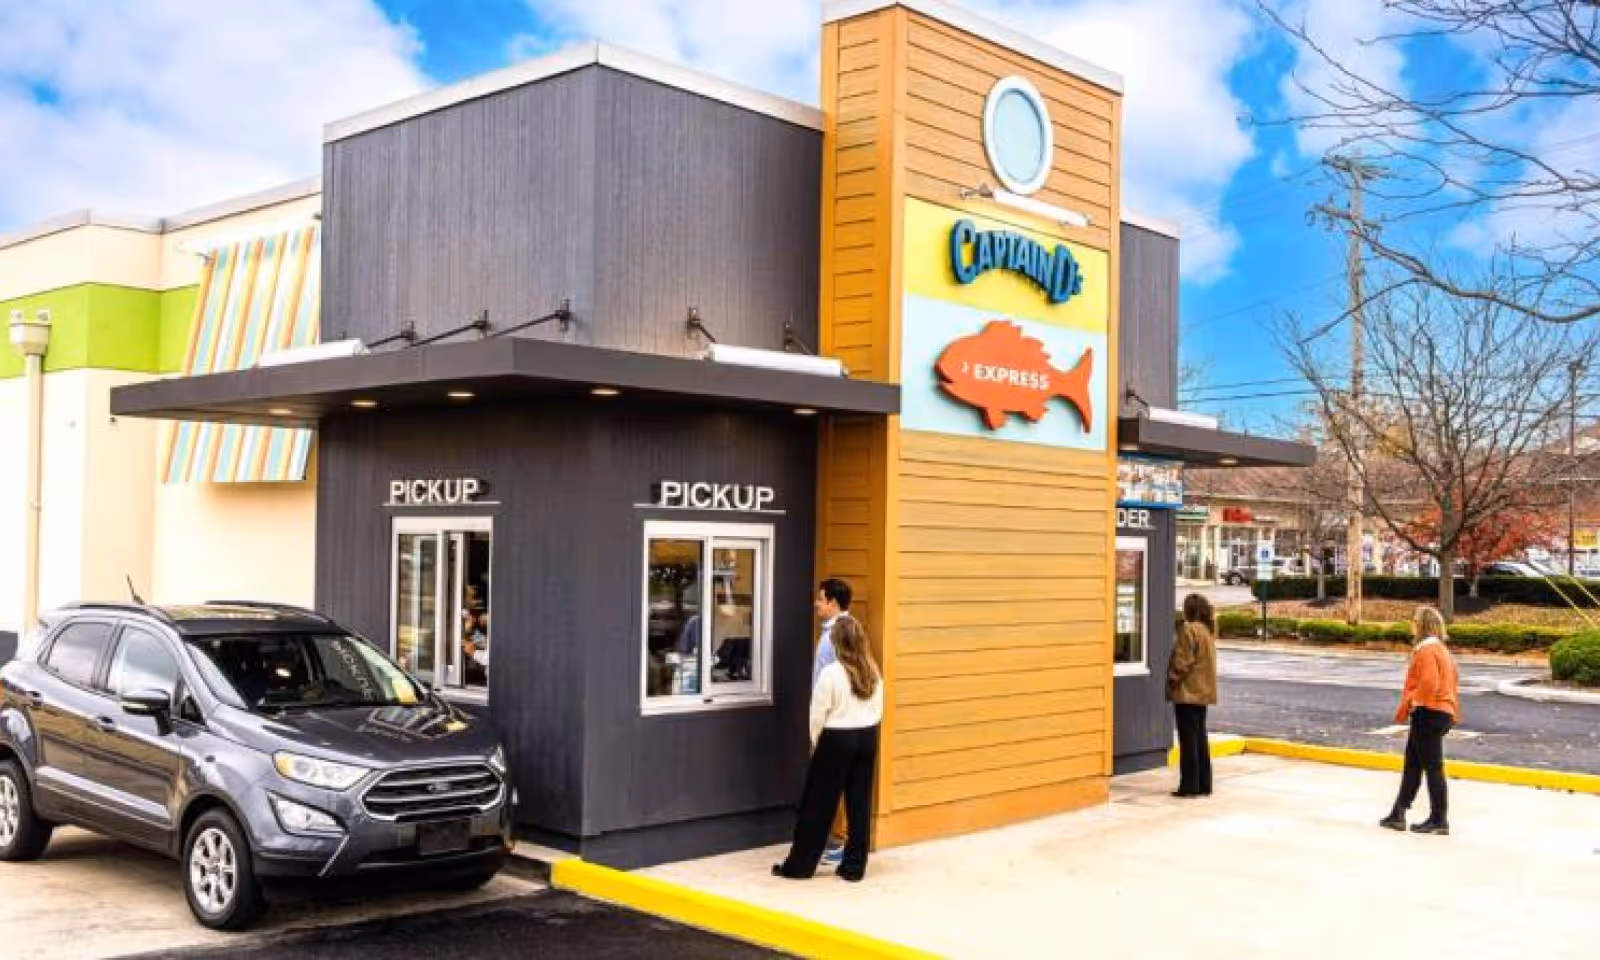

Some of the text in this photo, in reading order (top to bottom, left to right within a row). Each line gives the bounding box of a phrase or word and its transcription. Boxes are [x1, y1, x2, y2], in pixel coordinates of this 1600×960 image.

[974, 363, 1049, 391] EXPRESS
[389, 478, 479, 504] PICKUP
[660, 480, 774, 511] PICKUP
[1116, 508, 1151, 528] DER
